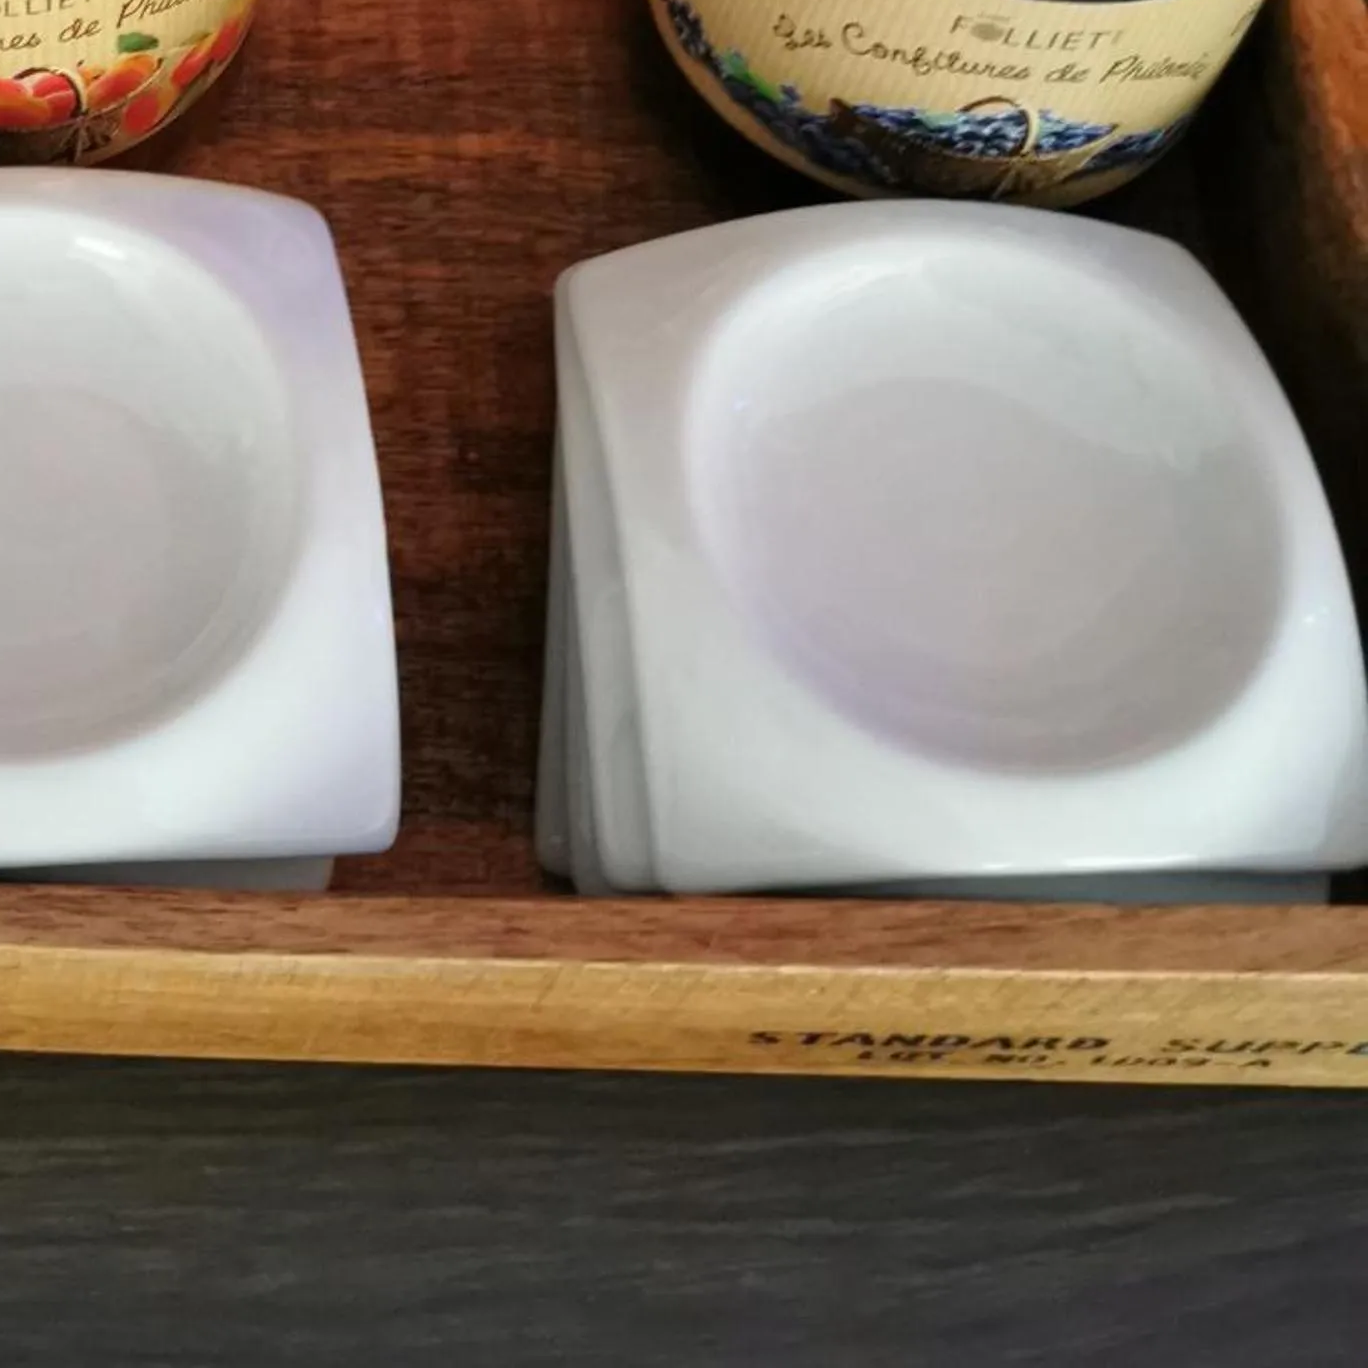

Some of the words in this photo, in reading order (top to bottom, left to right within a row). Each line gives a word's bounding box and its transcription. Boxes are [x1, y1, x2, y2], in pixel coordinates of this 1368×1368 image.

[58, 18, 101, 42] de
[842, 22, 1031, 81] Confitures
[1044, 62, 1092, 83] de
[748, 1032, 1112, 1050] STANDARD
